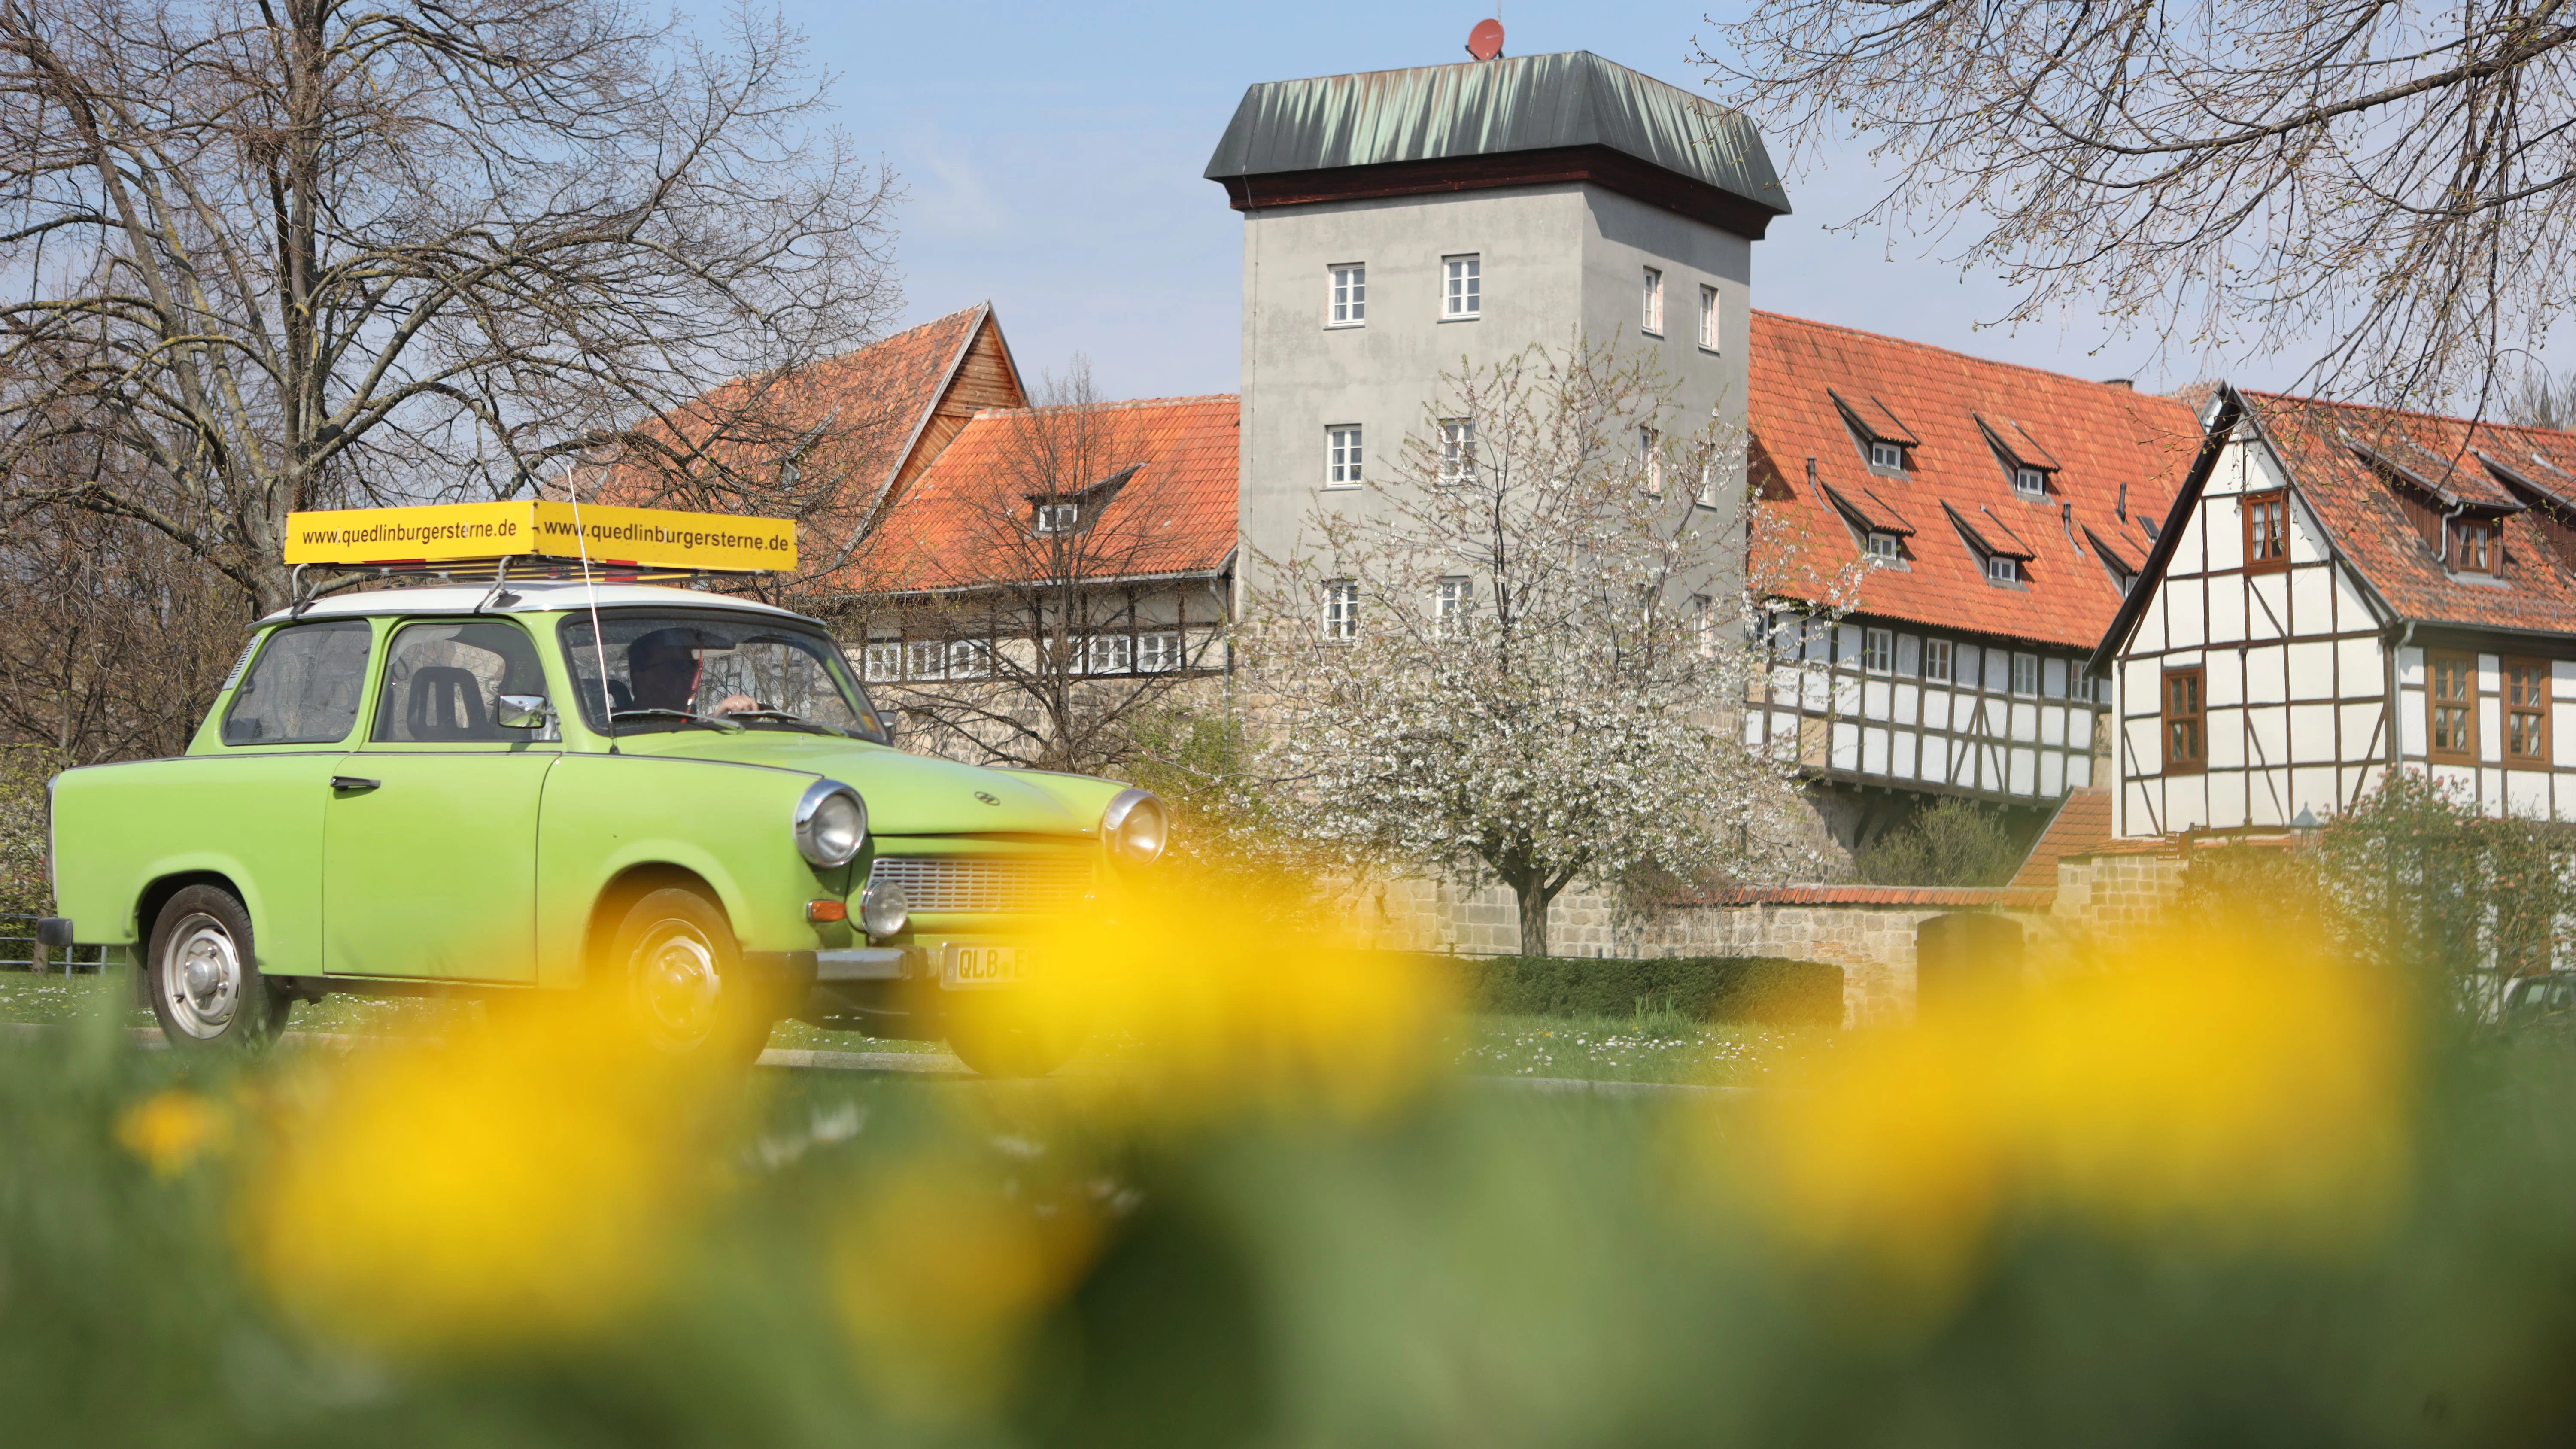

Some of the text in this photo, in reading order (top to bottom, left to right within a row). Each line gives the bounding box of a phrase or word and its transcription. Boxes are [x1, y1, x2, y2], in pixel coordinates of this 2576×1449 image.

[303, 519, 516, 547] www.quedlinburgersterne.de
[544, 521, 789, 550] www.quedlinburgersterne.de
[960, 949, 998, 978] QLB
